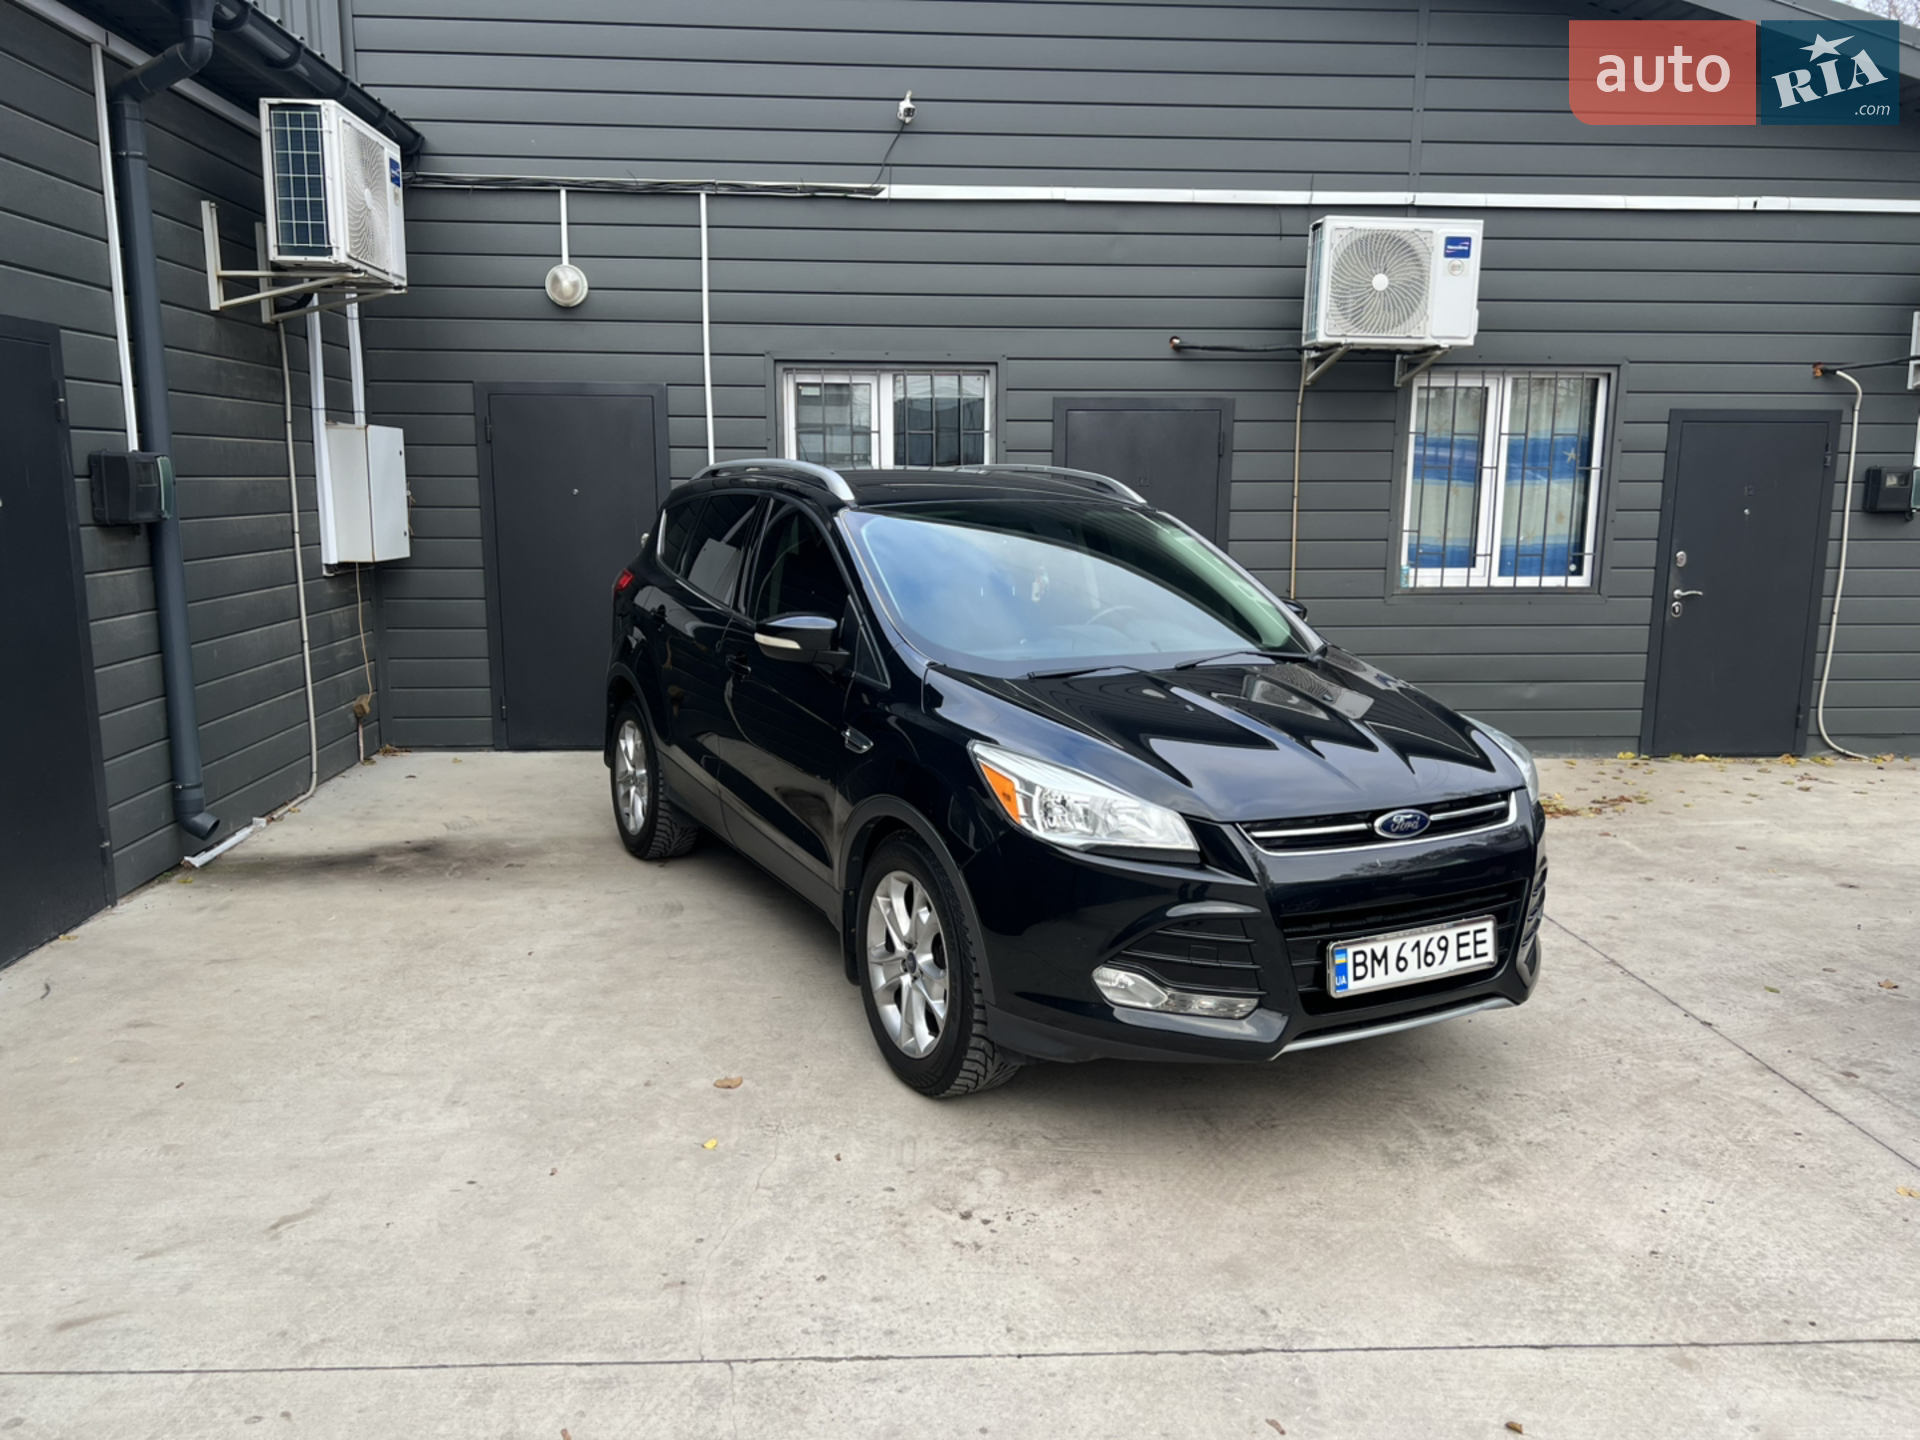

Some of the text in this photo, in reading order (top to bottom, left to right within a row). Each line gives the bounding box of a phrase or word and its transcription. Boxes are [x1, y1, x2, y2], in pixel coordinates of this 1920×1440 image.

[1390, 813, 1421, 833] Ford
[1352, 945, 1389, 982] BM
[1395, 935, 1449, 973] 6169
[1456, 928, 1489, 962] EE
[1335, 975, 1348, 986] UA
